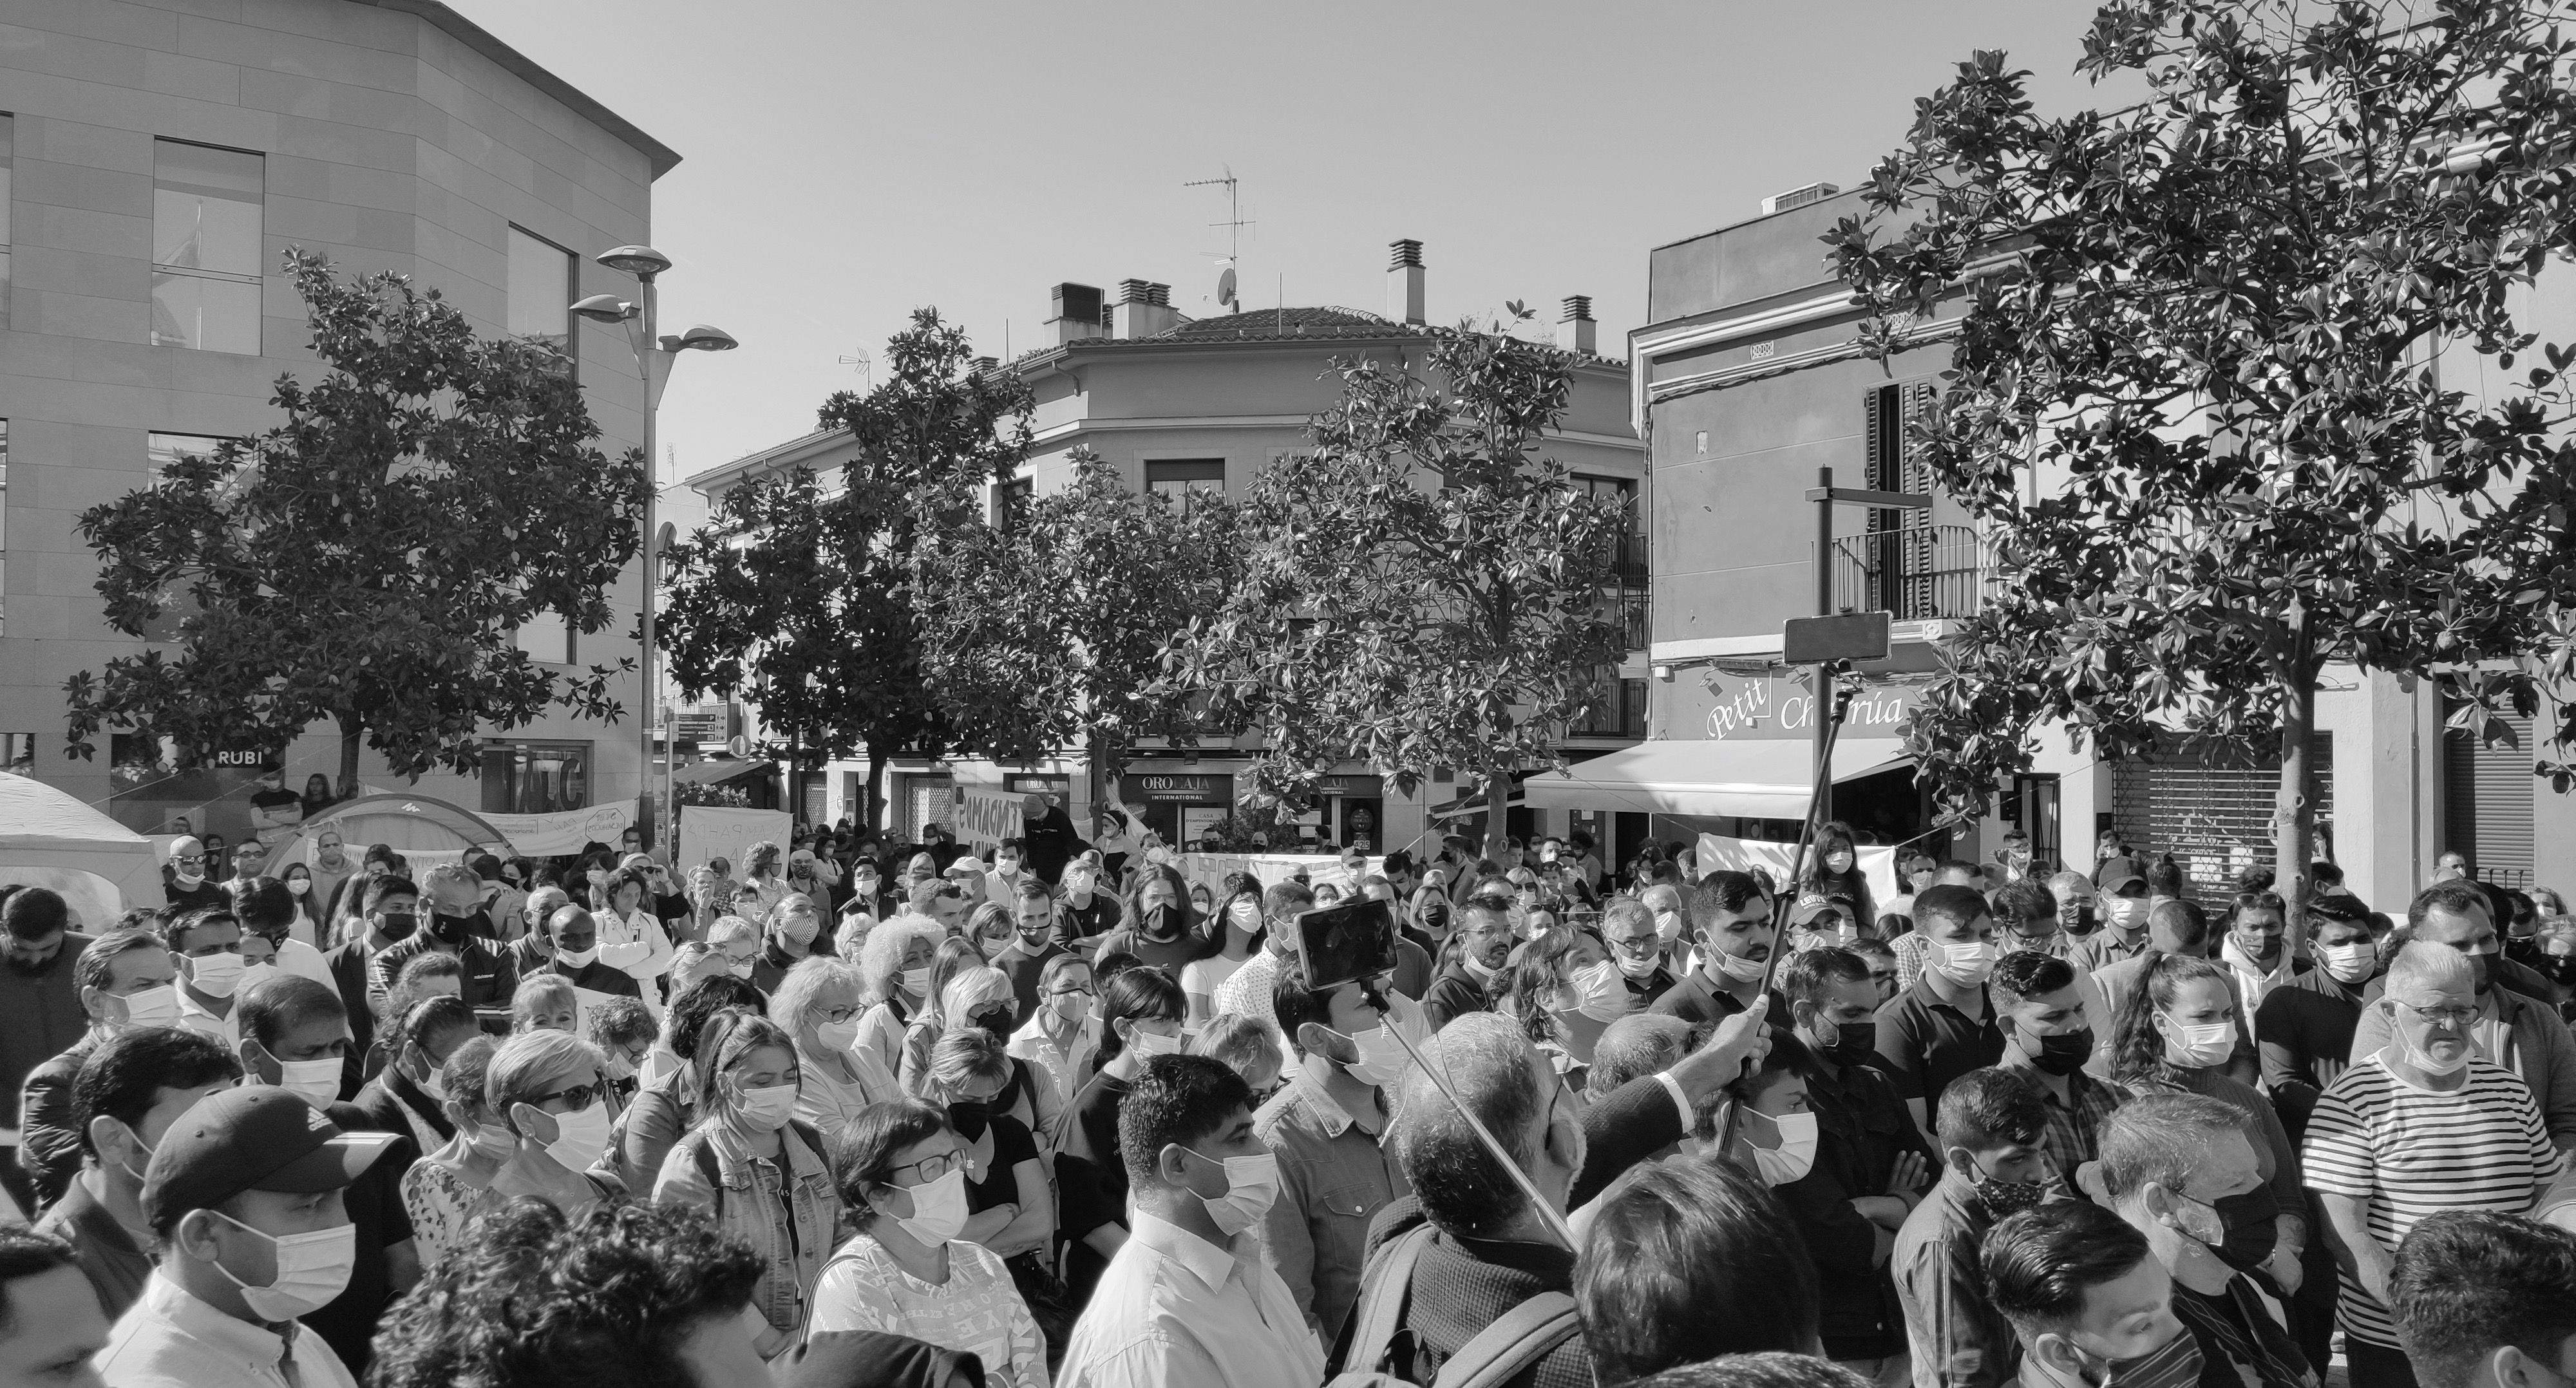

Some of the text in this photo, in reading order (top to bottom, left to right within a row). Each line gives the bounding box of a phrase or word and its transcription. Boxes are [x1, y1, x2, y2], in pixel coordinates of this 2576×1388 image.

[1707, 678, 1904, 741] Petit Chrúa
[218, 751, 262, 765] RUBI
[1142, 776, 1209, 791] OROCAJA
